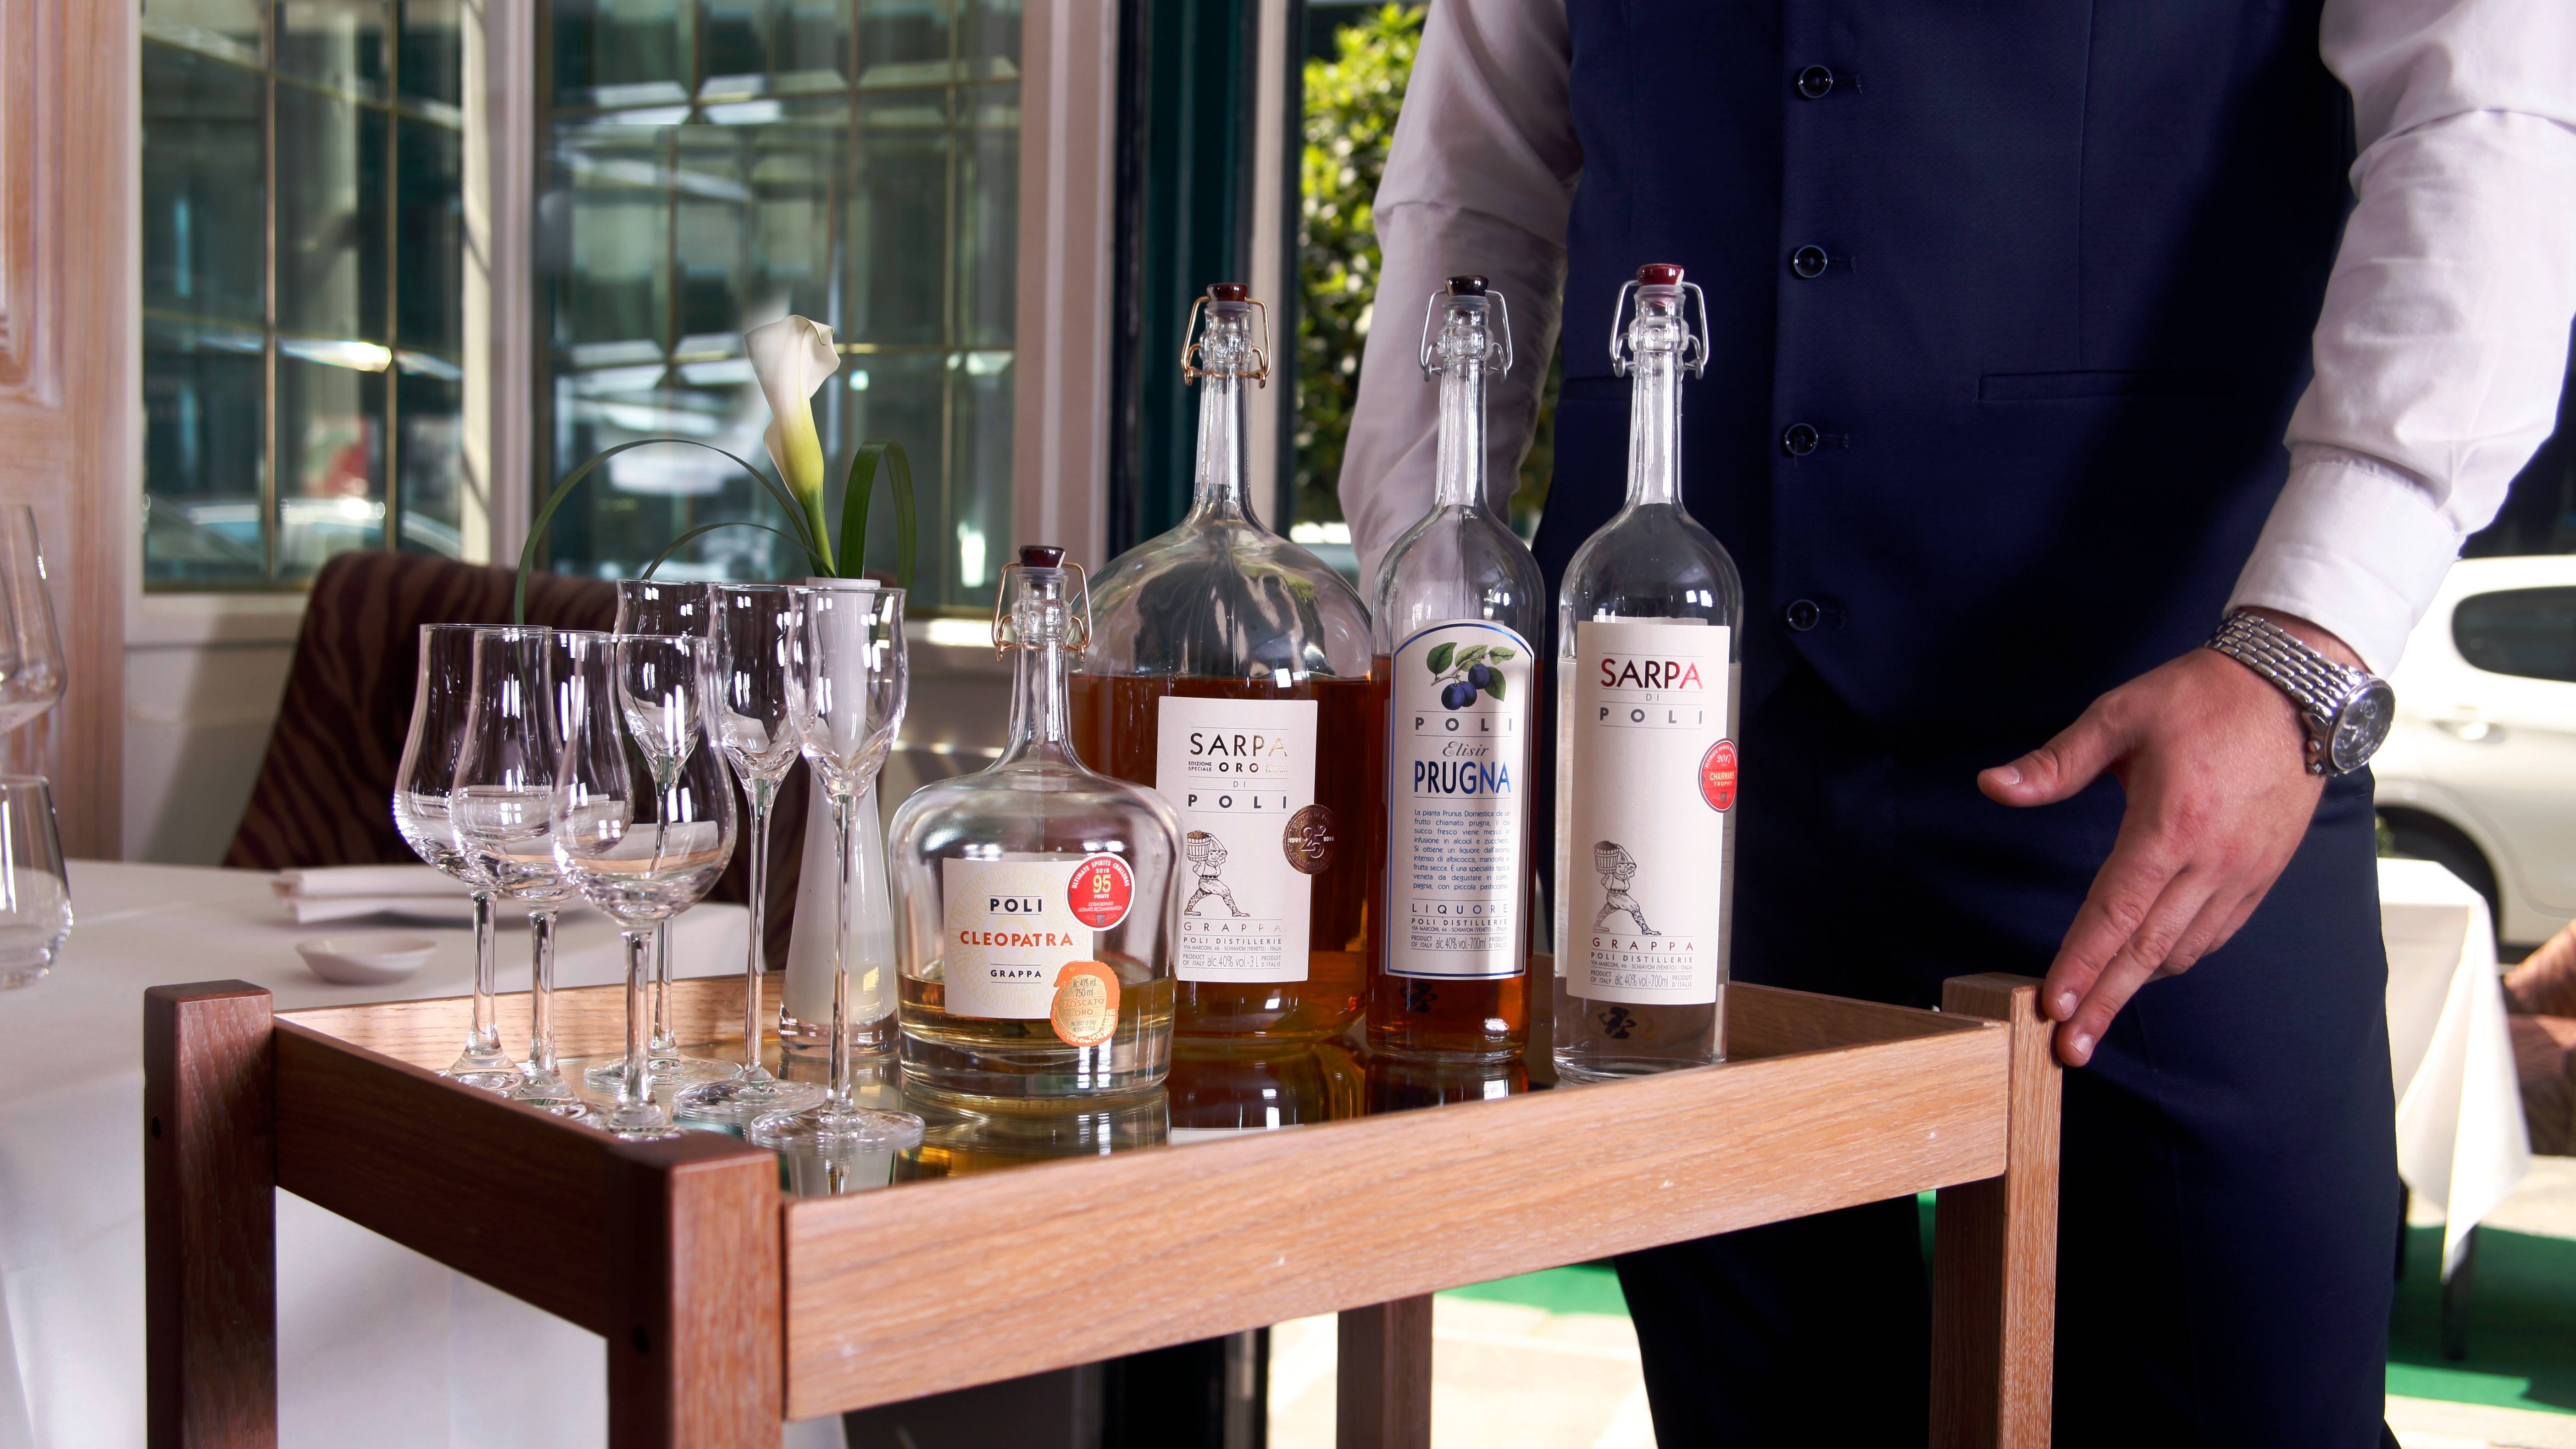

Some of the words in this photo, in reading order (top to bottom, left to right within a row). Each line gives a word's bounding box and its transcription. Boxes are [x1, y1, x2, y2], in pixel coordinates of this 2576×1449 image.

[1600, 658, 1704, 689] SARPA
[1599, 707, 1702, 724] POLI
[1416, 717, 1512, 732] POLI
[1190, 733, 1288, 756] SARPA
[1442, 741, 1489, 756] Elisir
[1717, 754, 1732, 763] 2017
[1219, 762, 1259, 772] ORO
[1414, 760, 1511, 794] PRUGNA
[1188, 794, 1287, 809] POLI
[1071, 866, 1090, 888] ULTIMATE
[1091, 860, 1111, 868] SPIRITS
[1113, 863, 1130, 887] CHALLENGE
[1093, 874, 1111, 894] 95
[990, 898, 1042, 912] POLI
[1412, 904, 1507, 914] LIQUORE
[1184, 922, 1282, 932] GRAPPA
[960, 931, 1073, 947] CLEOPATRA
[1593, 938, 1693, 951] GRAPPA
[1591, 952, 1614, 960] POLI
[1075, 988, 1086, 997] 750
[1087, 988, 1094, 996] ml
[1064, 998, 1104, 1006] MOSCATO
